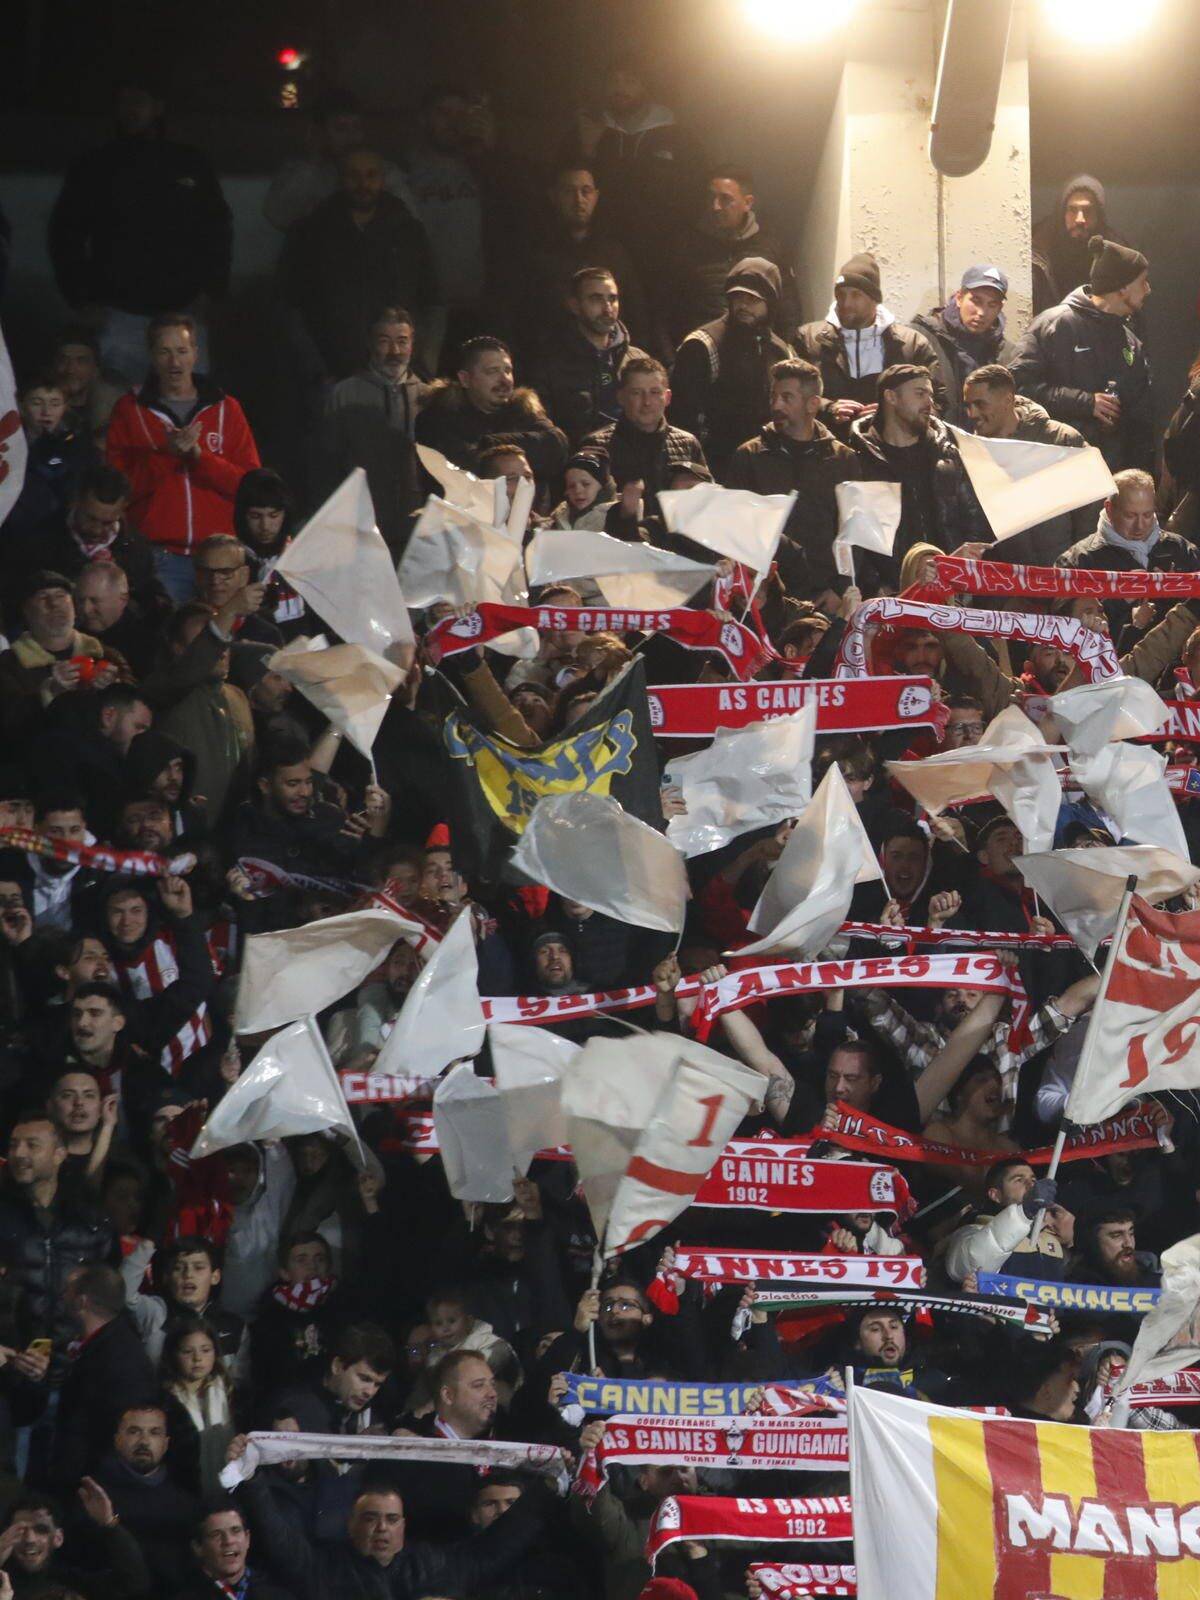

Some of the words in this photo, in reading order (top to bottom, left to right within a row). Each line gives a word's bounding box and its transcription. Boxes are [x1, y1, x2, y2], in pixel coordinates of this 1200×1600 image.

[538, 610, 567, 630] AS
[577, 612, 672, 632] CANNES
[719, 689, 747, 710] AS
[735, 955, 931, 999] ANNES
[722, 1160, 816, 1186] CANNES
[727, 1187, 768, 1203] 1902
[683, 1255, 848, 1280] ANNES
[602, 1430, 628, 1450] AS
[635, 1430, 717, 1452] CANNES
[736, 1498, 768, 1514] AS
[773, 1497, 853, 1515] CANNE
[786, 1519, 827, 1536] 1902
